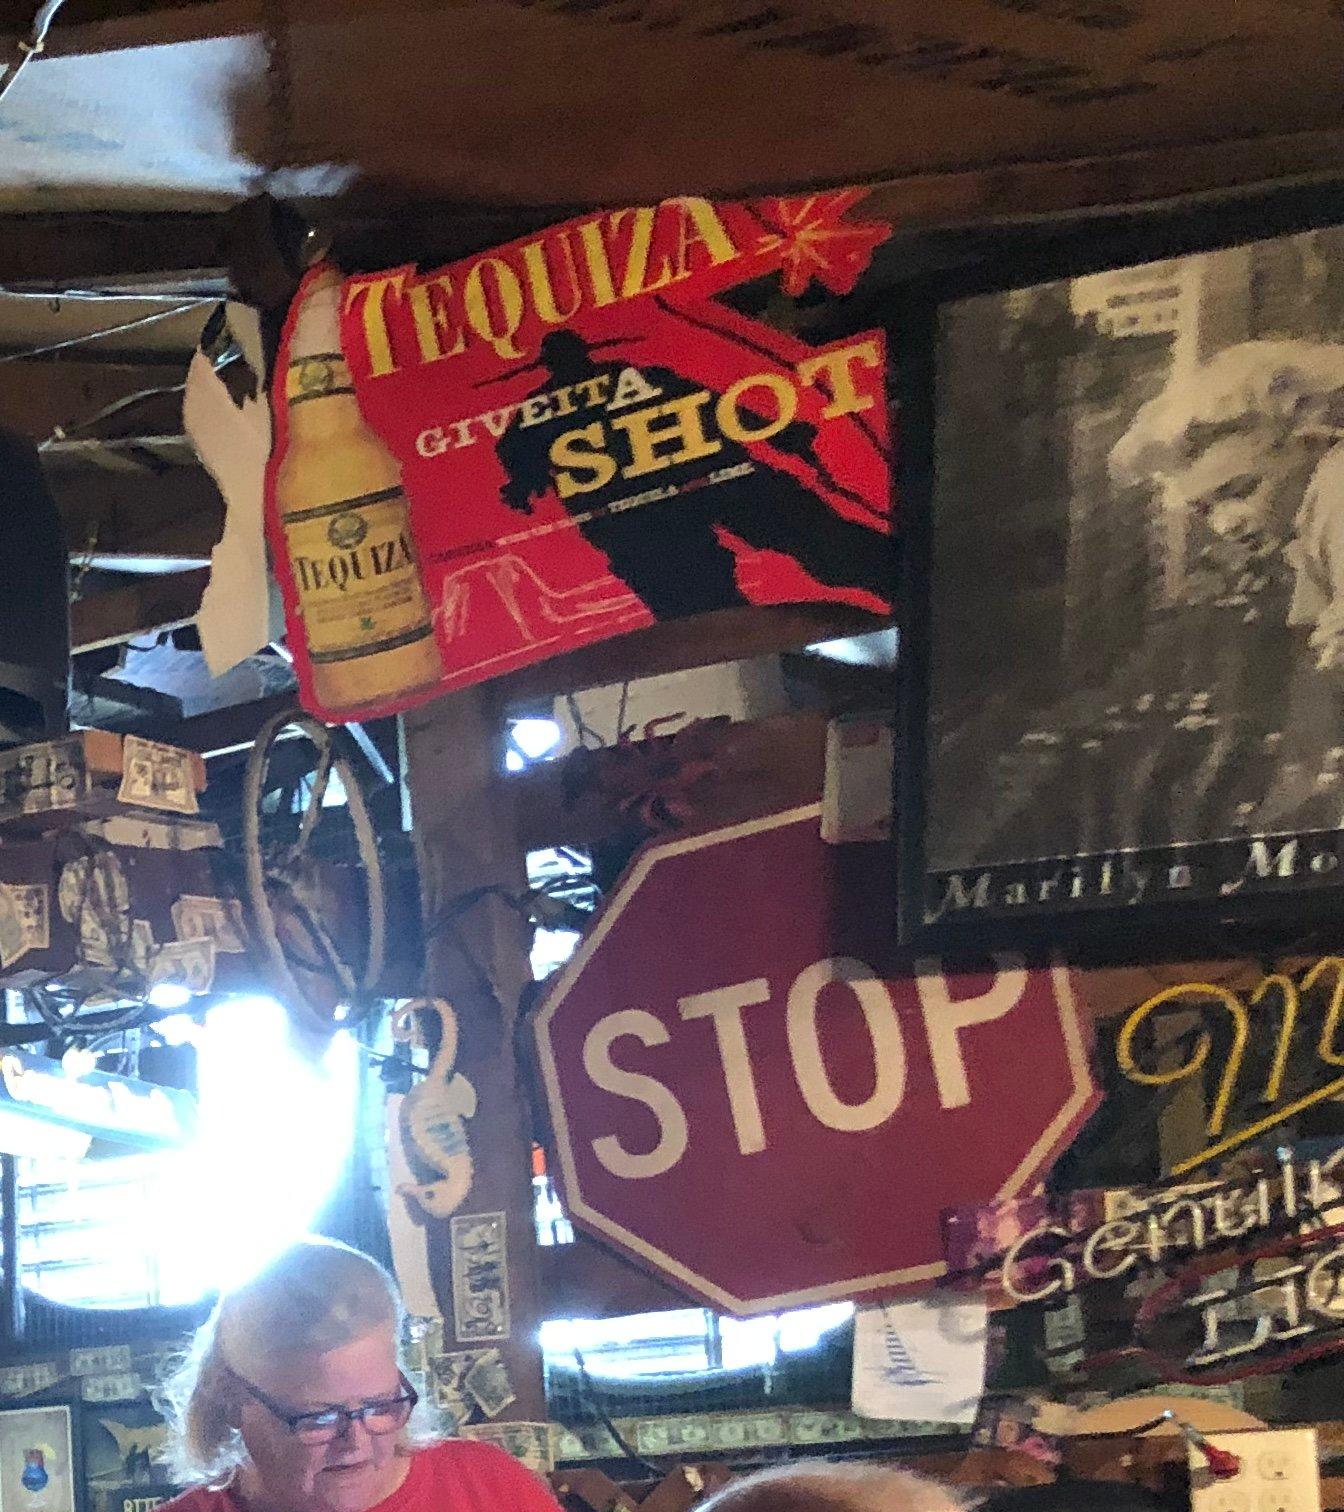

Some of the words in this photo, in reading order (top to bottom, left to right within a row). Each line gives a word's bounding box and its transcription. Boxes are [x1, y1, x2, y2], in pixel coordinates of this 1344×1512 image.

[343, 195, 739, 382] TEQUIZA
[414, 393, 554, 460] GIVE
[556, 374, 612, 420] IT
[606, 367, 663, 412] A
[548, 338, 882, 500] SHOT
[295, 532, 413, 592] TEQUIZA
[922, 858, 1193, 925] Marilyn
[581, 951, 1028, 1181] STOP
